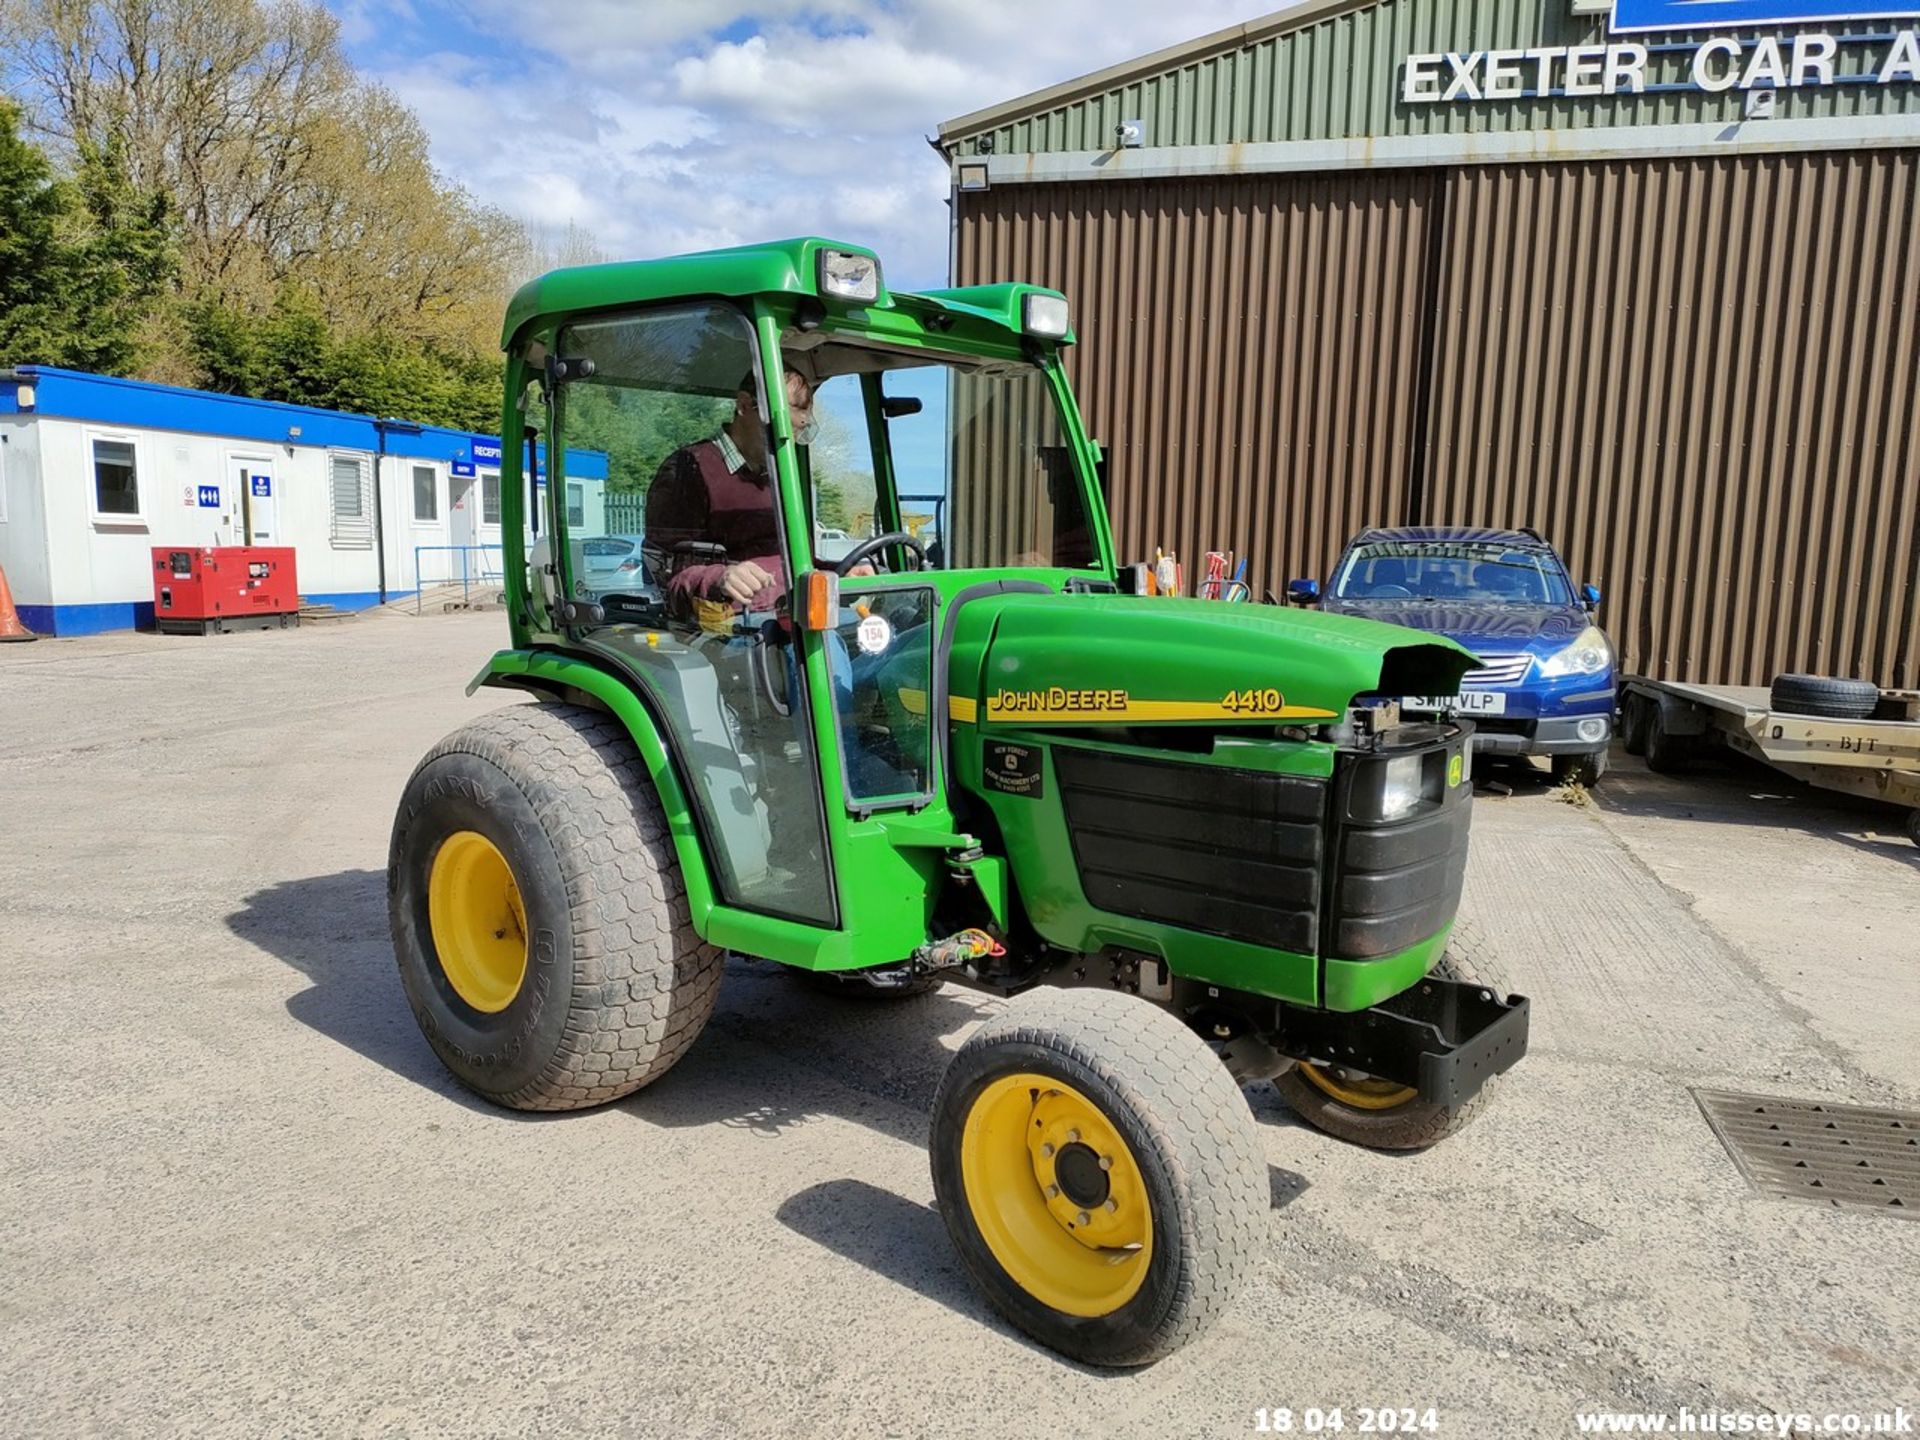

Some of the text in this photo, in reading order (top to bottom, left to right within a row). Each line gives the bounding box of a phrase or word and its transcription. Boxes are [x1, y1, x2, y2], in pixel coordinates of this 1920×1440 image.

[1404, 30, 1920, 102] EXETER CAR A
[864, 628, 883, 641] 154
[992, 687, 1128, 712] JOHN DEERE
[1222, 688, 1282, 712] 4410
[1460, 694, 1494, 710] VLP
[1840, 736, 1879, 753] BJT
